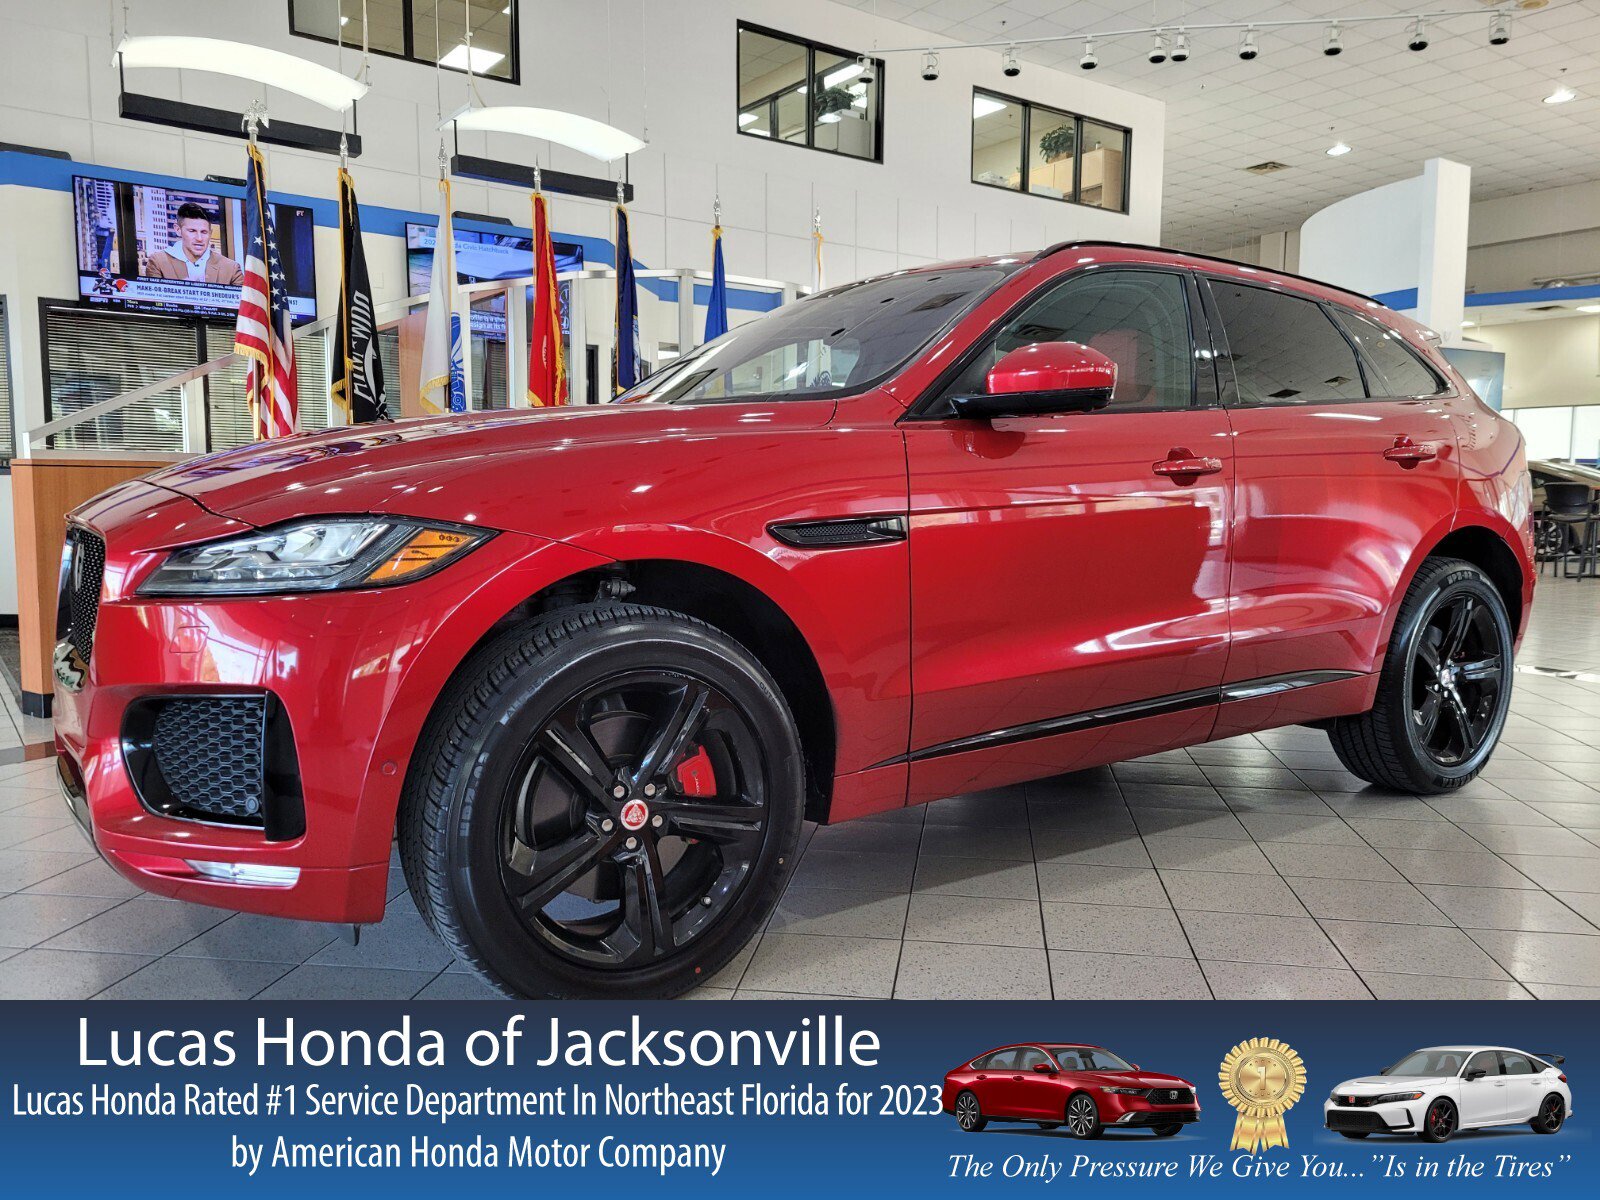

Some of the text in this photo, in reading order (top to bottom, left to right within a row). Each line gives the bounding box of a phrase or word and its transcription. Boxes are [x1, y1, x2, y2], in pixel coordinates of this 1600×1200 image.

[478, 244, 509, 255] Hatchback
[136, 283, 181, 294] MAKE-OR-BREAK
[182, 288, 198, 296] START
[89, 296, 108, 304] ESPN
